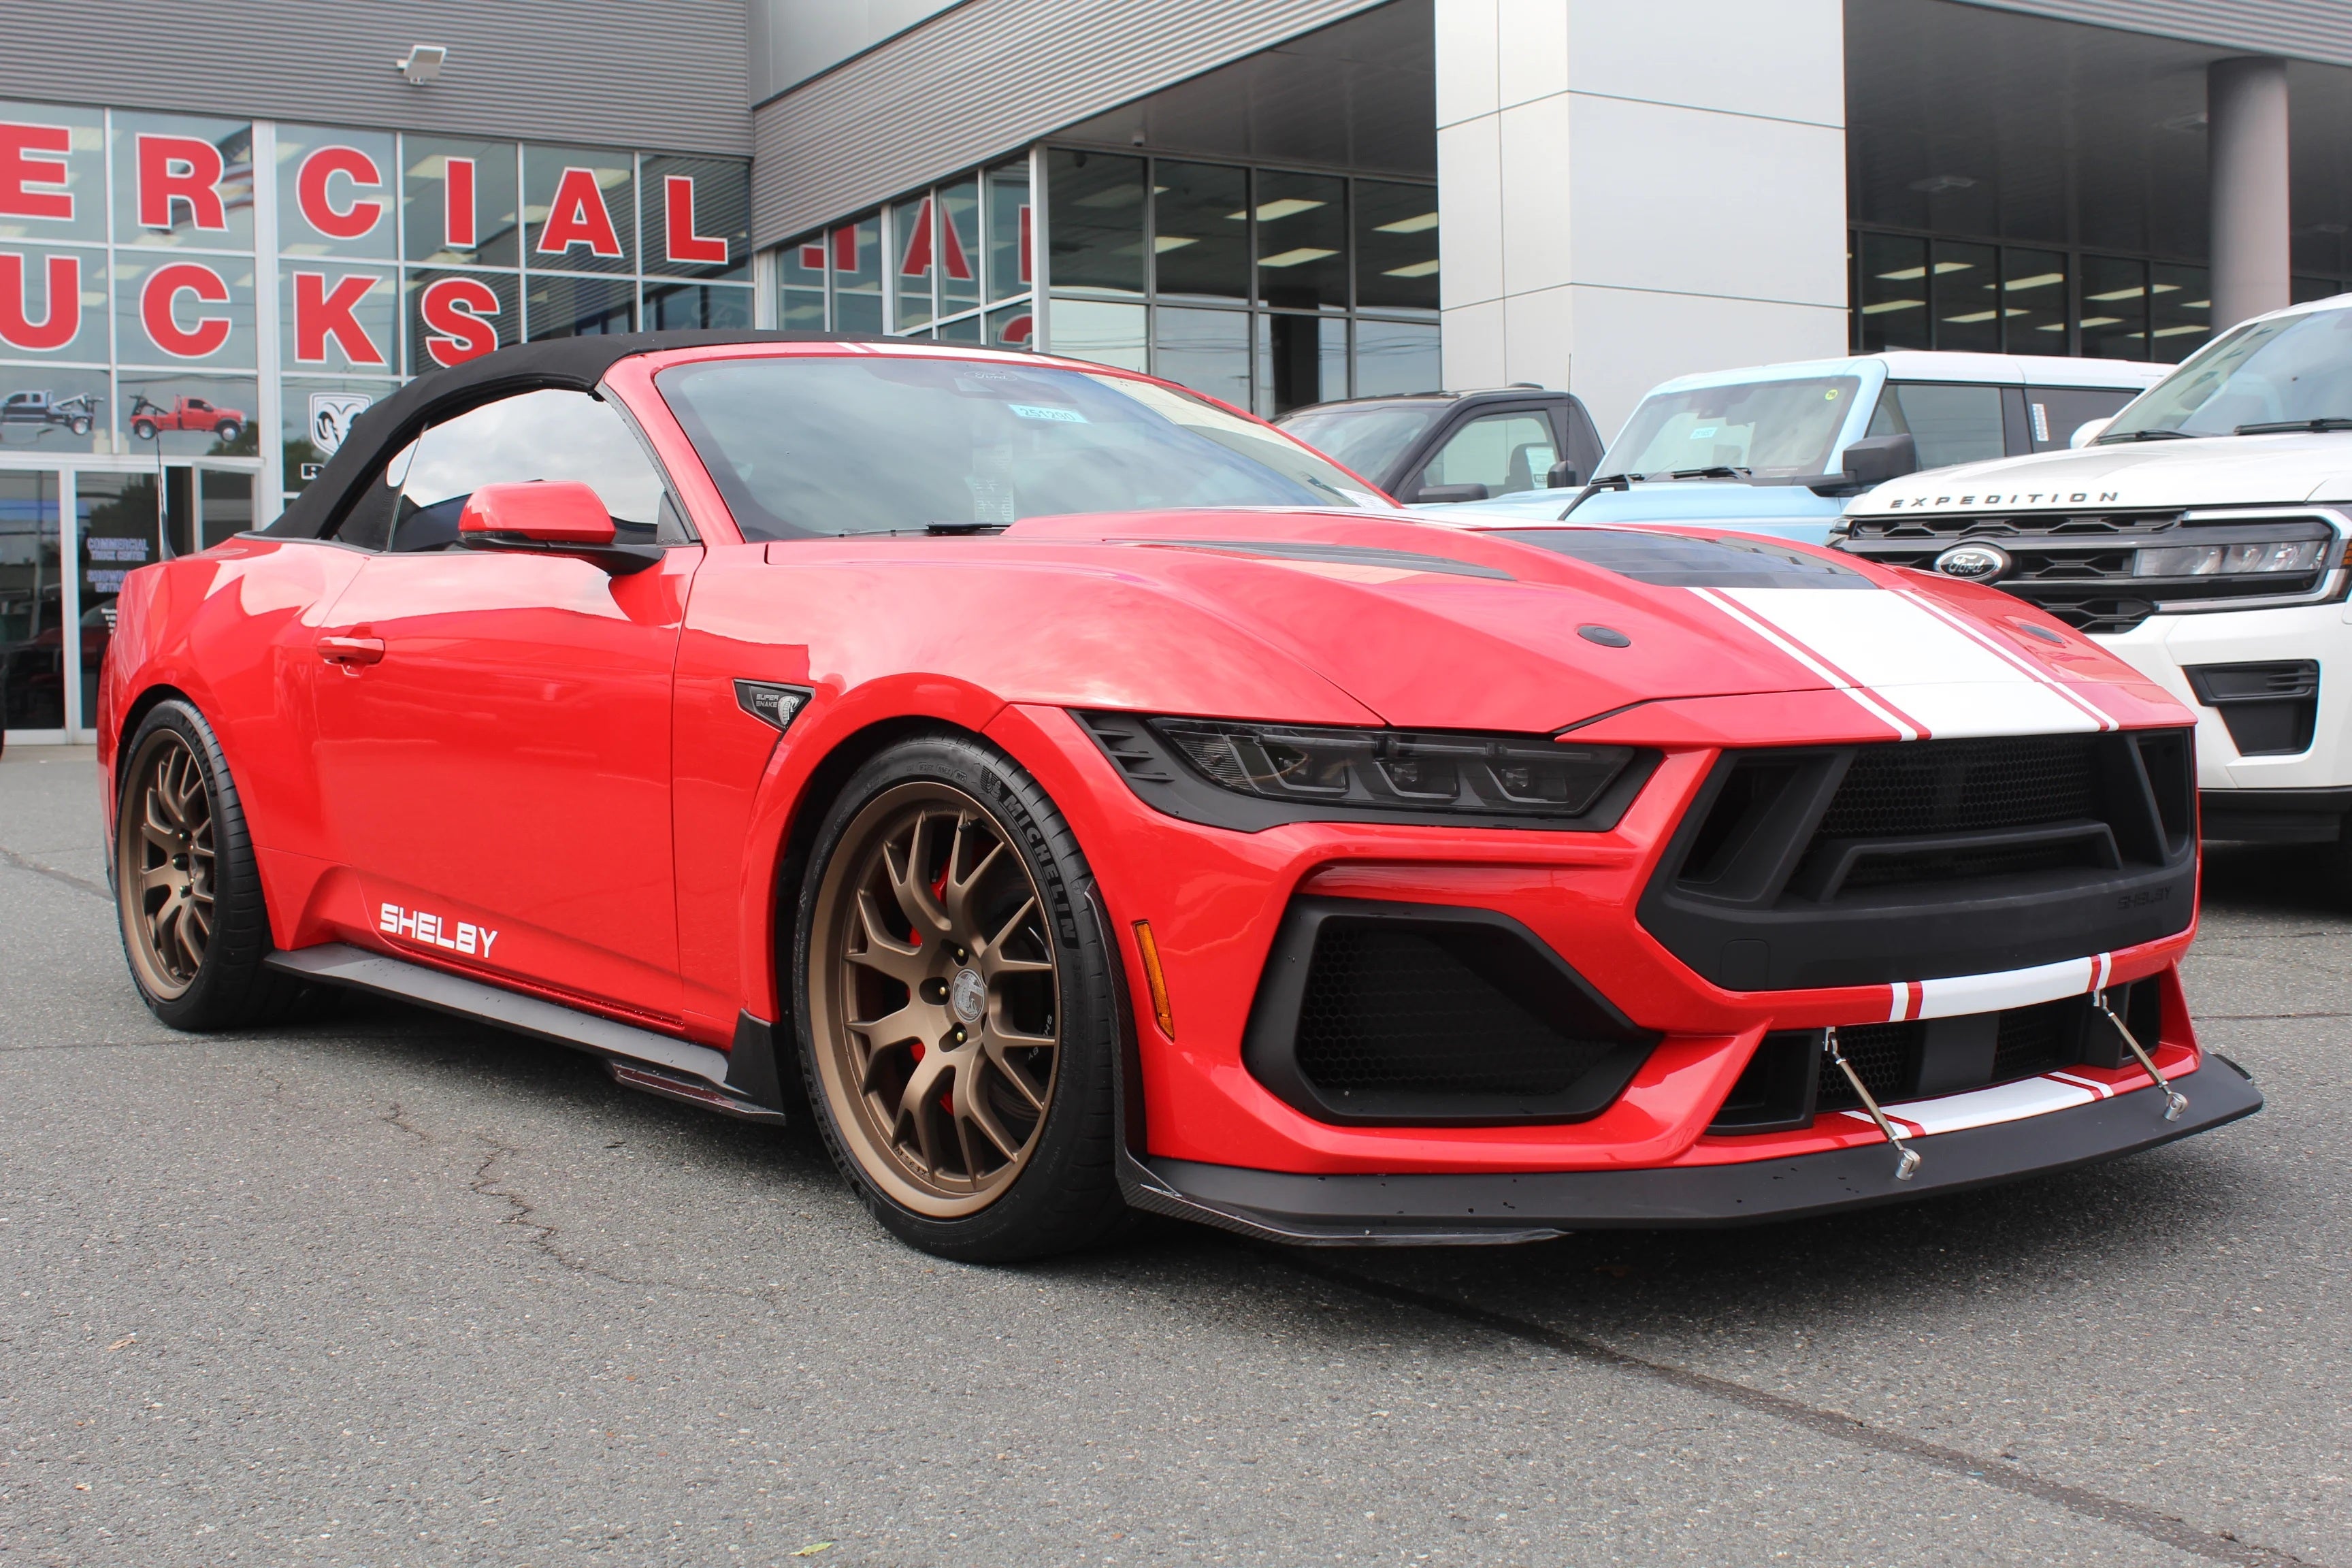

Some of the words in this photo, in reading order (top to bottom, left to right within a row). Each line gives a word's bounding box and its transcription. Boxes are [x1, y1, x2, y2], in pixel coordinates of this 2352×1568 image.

[1889, 492, 2119, 509] EXPEDITION
[1947, 554, 1986, 574] Ford
[1002, 794, 1077, 939] MICHELIN
[2117, 886, 2172, 910] SHELBY
[379, 902, 498, 959] SHELBY
